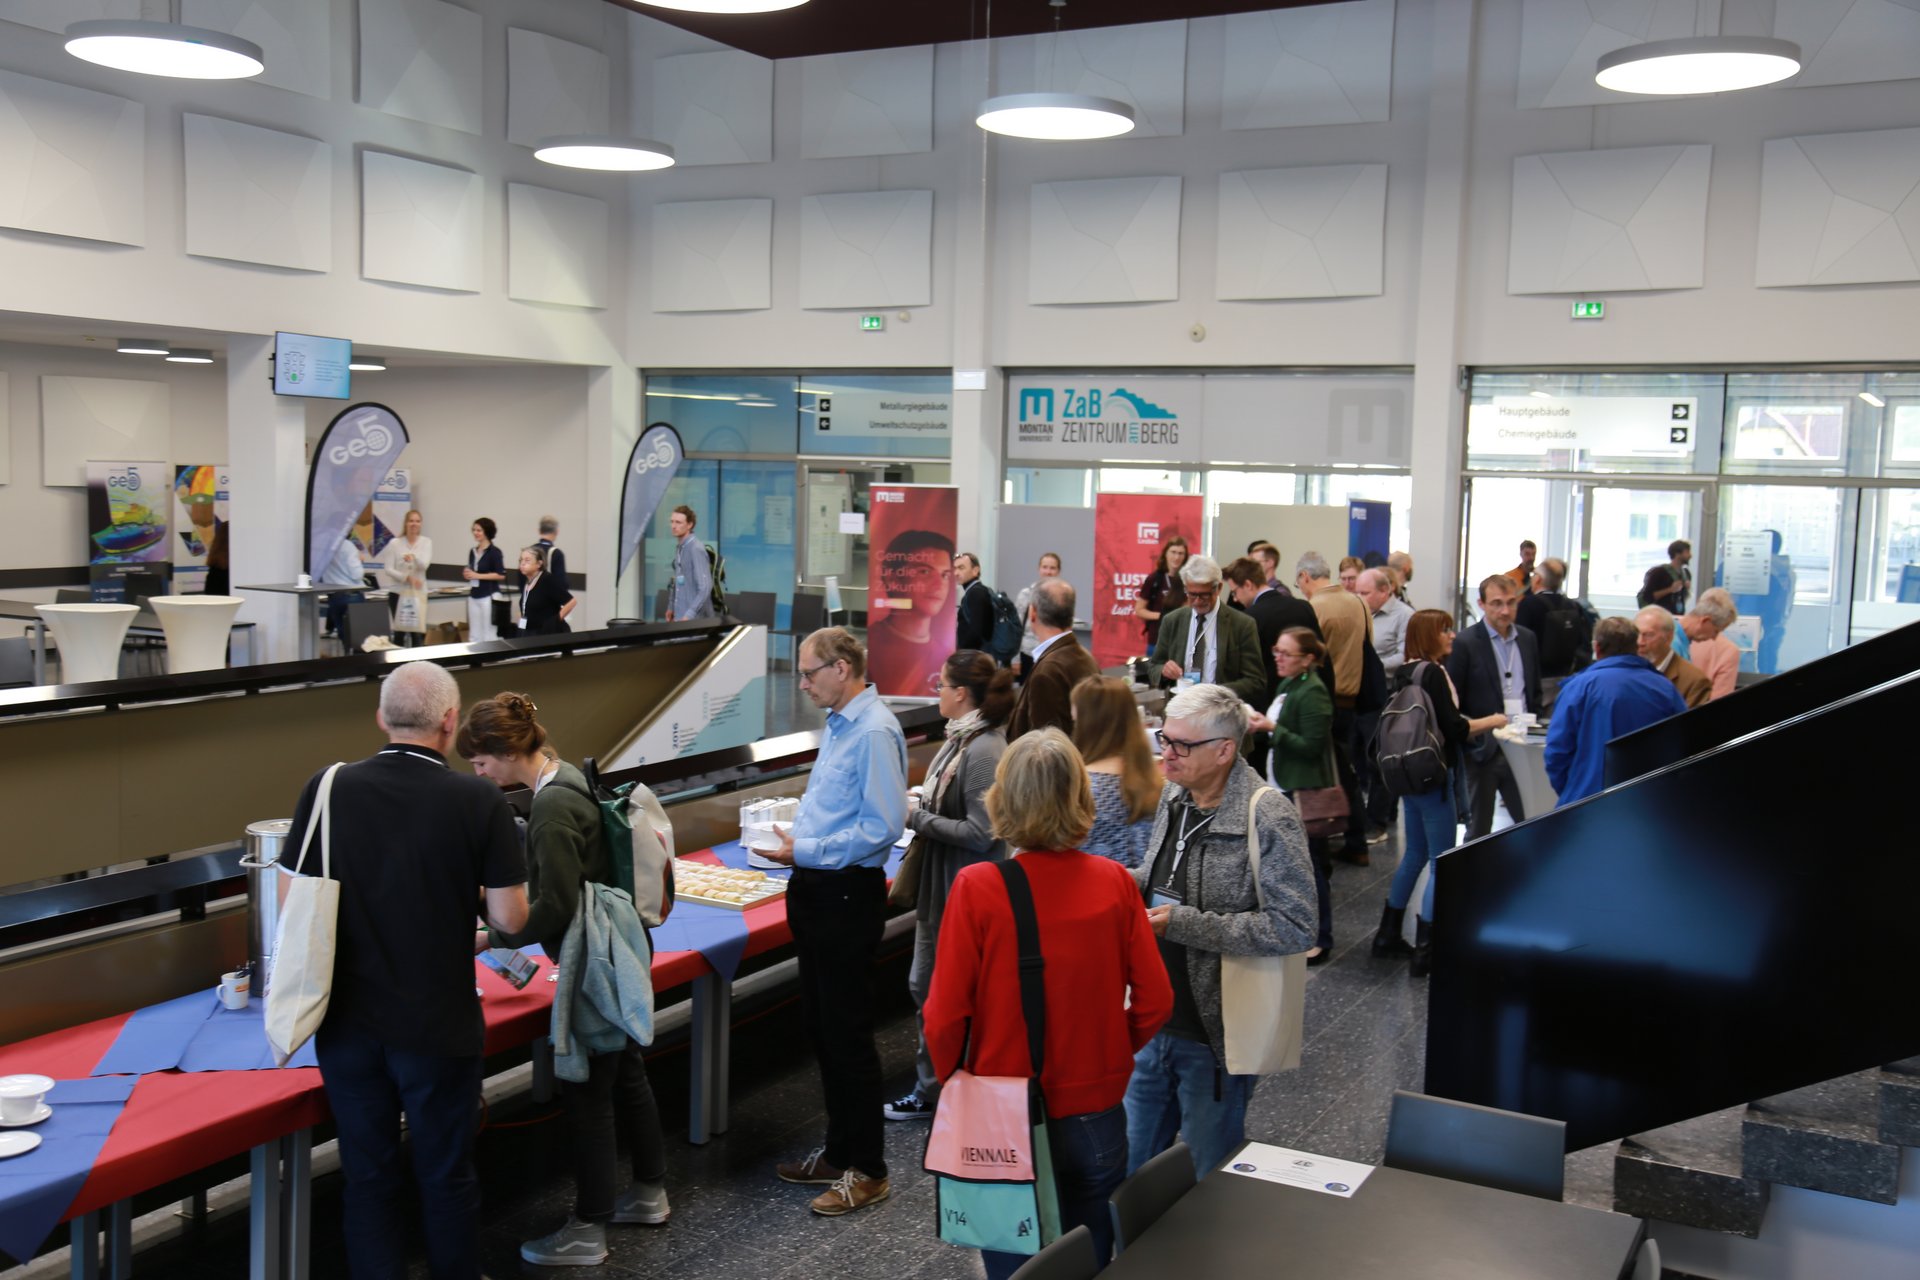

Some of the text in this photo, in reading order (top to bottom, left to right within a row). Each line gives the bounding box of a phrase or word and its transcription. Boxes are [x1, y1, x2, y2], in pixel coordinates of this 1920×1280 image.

[880, 402, 948, 412] Metallurgiegebäude
[1062, 389, 1102, 418] ZaB
[1499, 406, 1571, 418] Hauptgebäude
[869, 420, 948, 431] Umweltschutzgebäude
[1019, 424, 1054, 433] MONTAN
[1061, 422, 1179, 444] ZENTRUM am BERG
[1498, 429, 1577, 441] Chemiegebäude
[876, 550, 934, 562] Gemacht
[875, 565, 917, 577] für die
[875, 580, 926, 592] Zukunft
